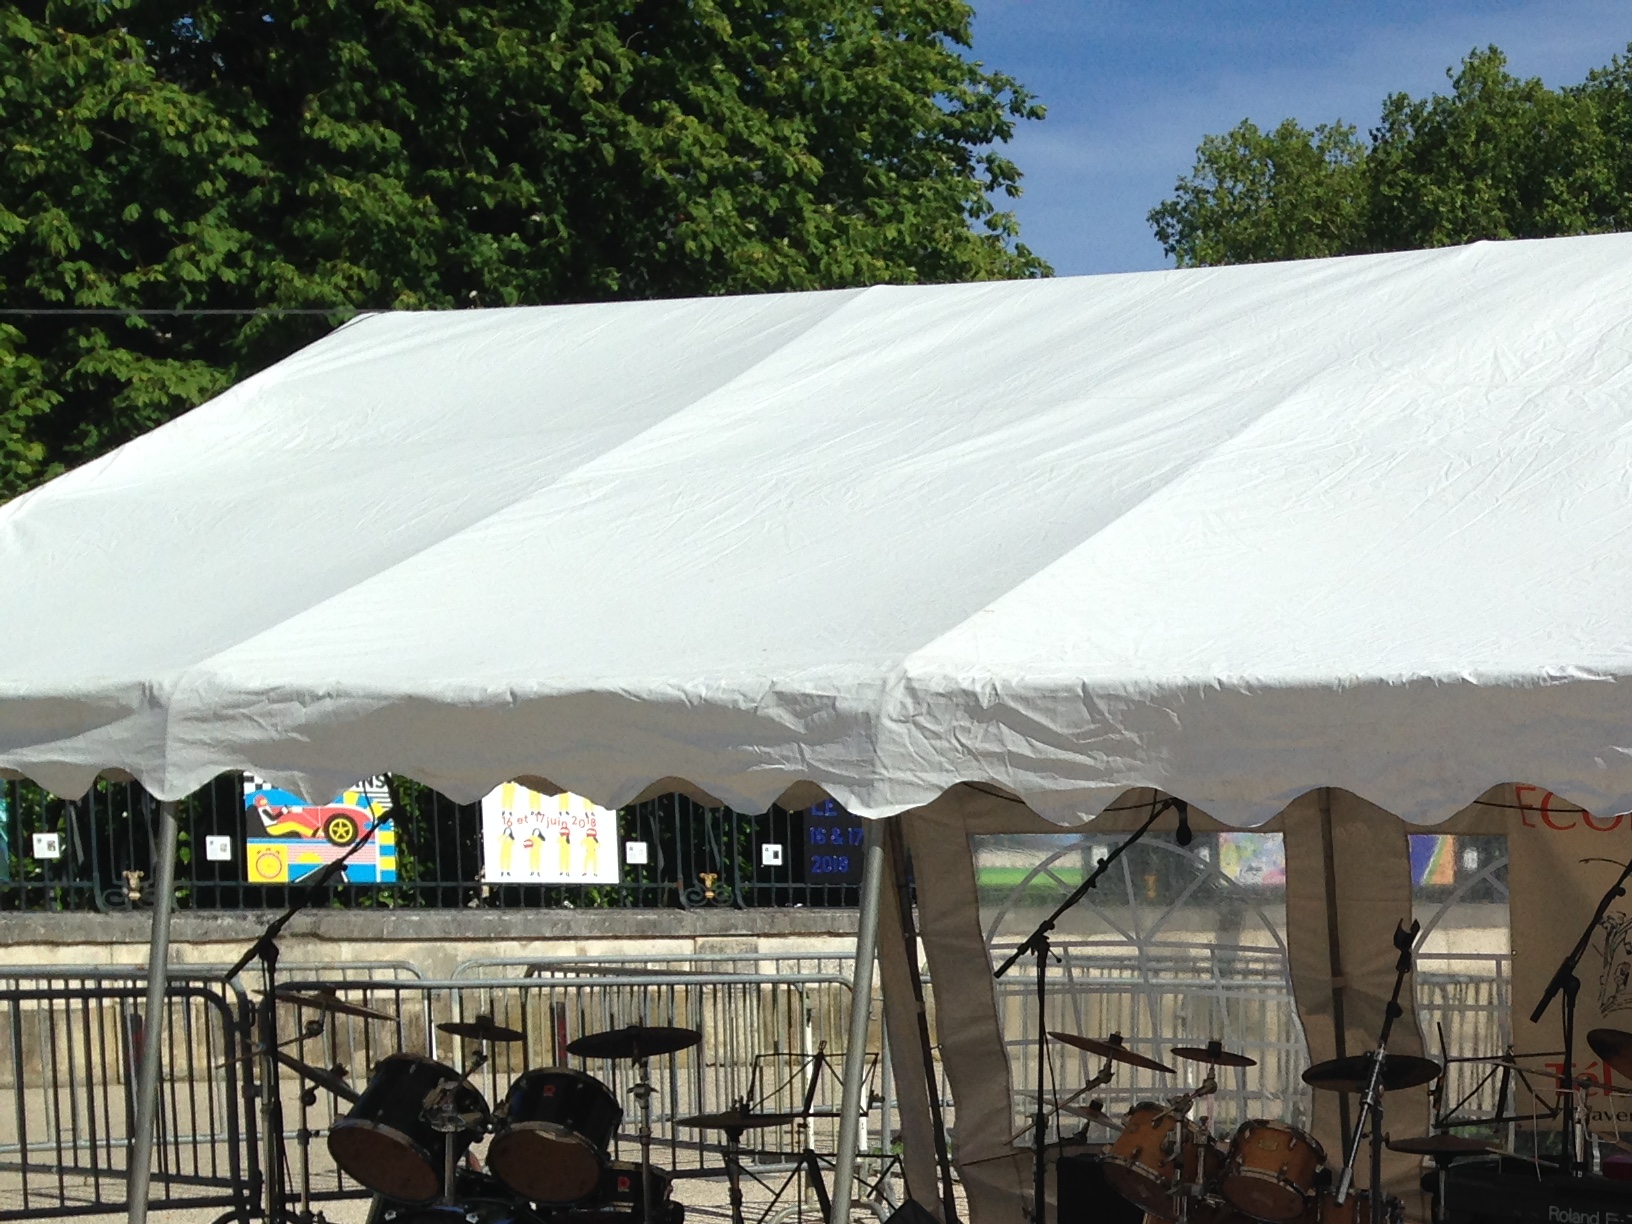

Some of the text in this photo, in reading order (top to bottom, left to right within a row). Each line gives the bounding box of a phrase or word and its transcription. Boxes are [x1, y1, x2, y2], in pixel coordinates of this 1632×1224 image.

[502, 813, 597, 829] 16 et 17 juin 2018
[809, 827, 864, 846] 16 & 17
[811, 855, 849, 873] 2018
